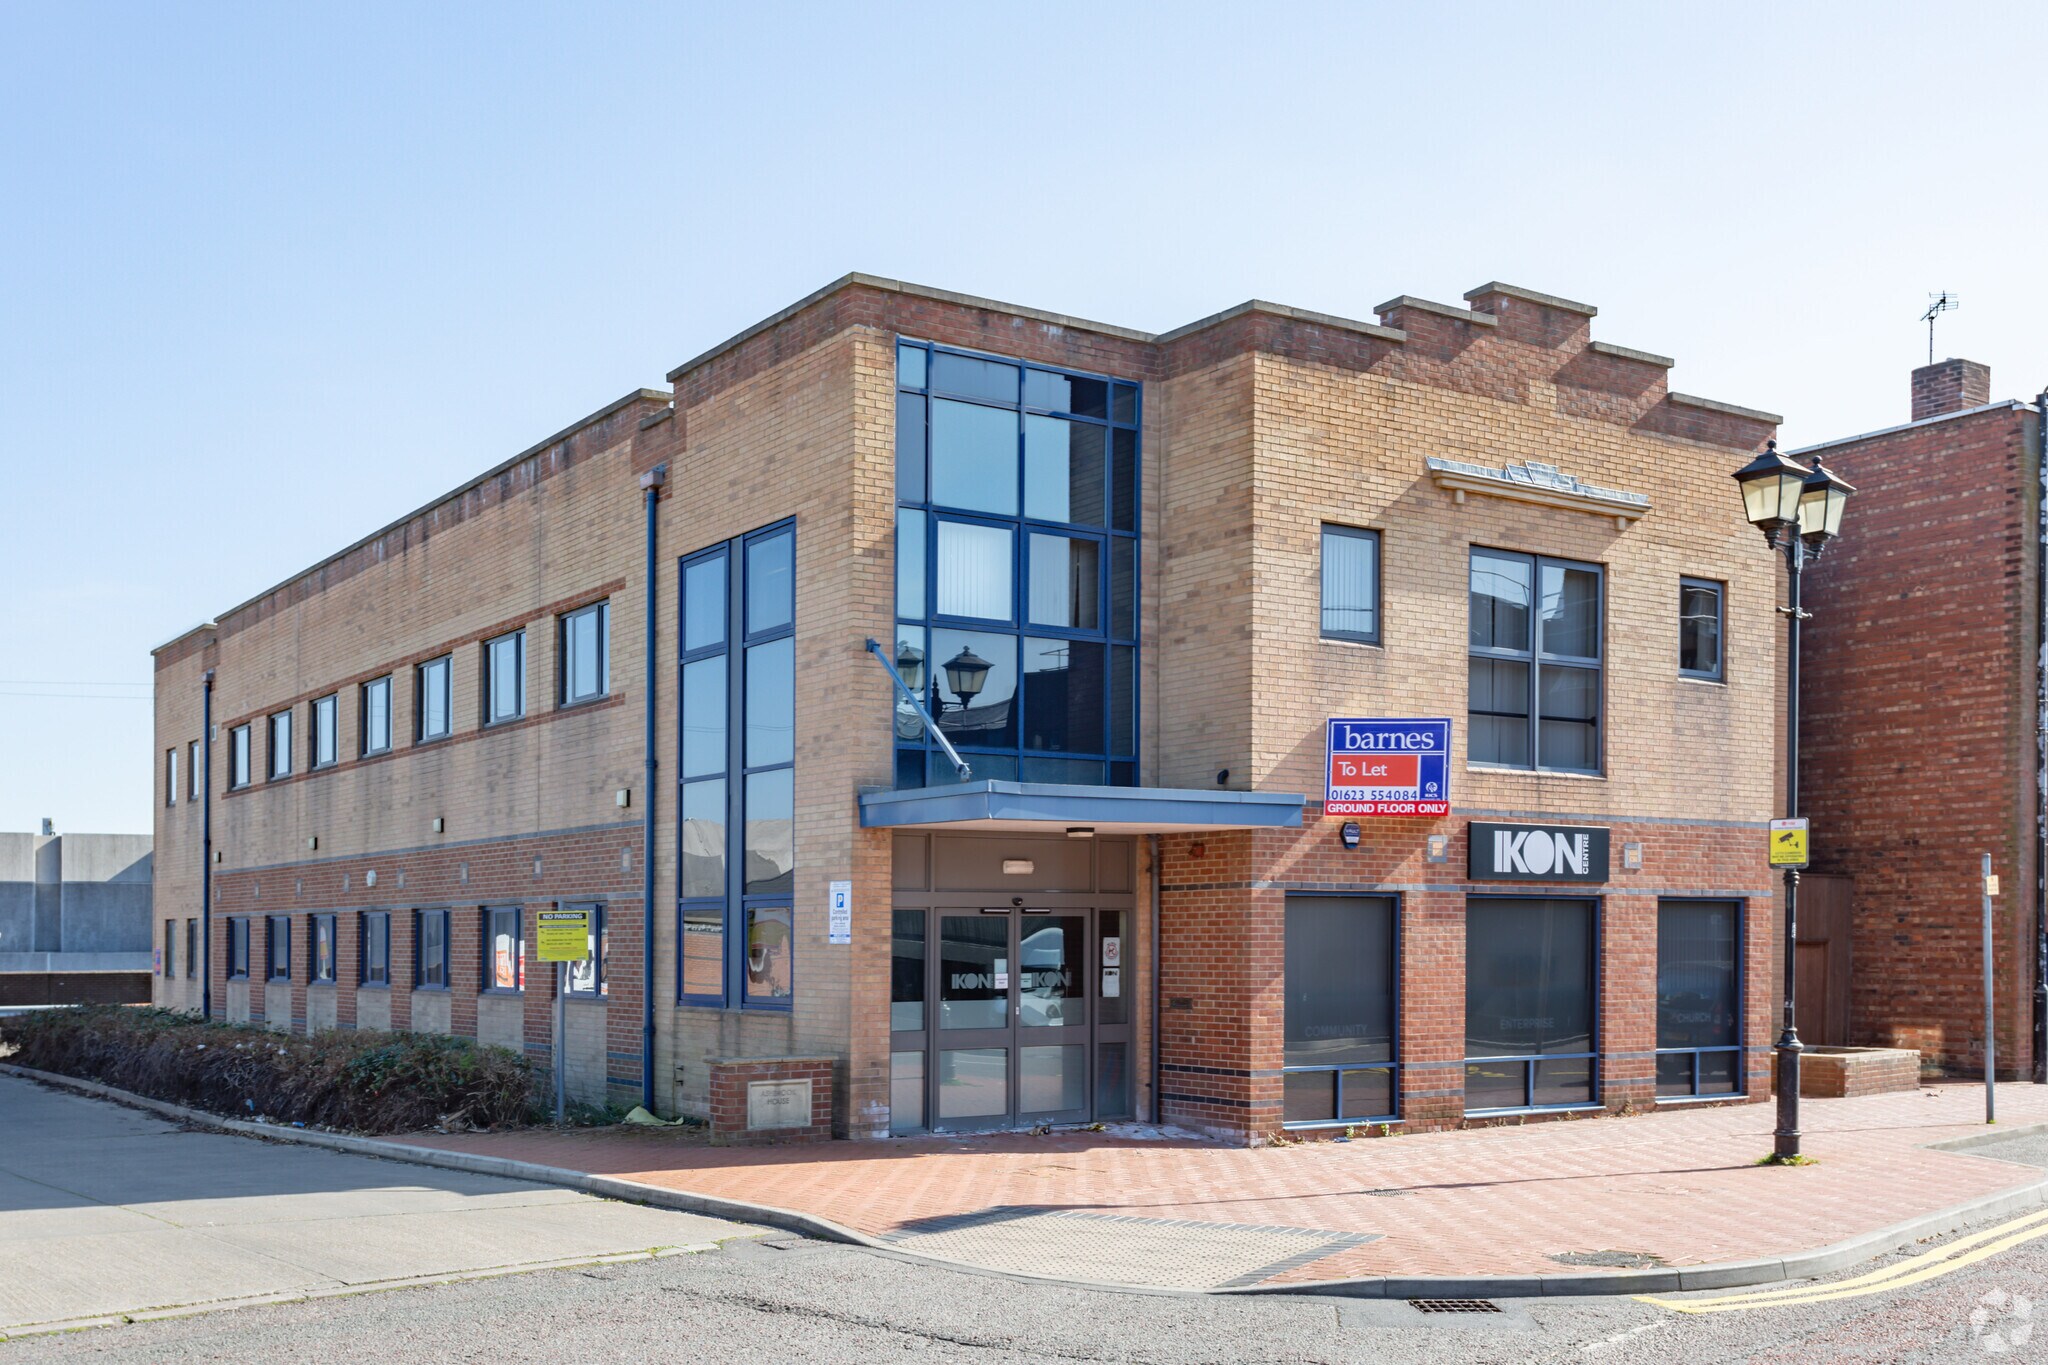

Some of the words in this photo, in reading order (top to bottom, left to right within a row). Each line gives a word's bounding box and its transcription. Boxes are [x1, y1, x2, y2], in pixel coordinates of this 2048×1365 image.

[1343, 725, 1435, 750] barnes
[1337, 761, 1357, 777] To
[1362, 761, 1388, 777] Let
[1331, 790, 1365, 801] 01623
[1371, 790, 1418, 801] 554084
[1327, 803, 1375, 814] GROUND
[1377, 803, 1415, 814] FLOOR
[1418, 803, 1447, 814] ONLY
[1493, 830, 1583, 875] IKON
[1582, 833, 1590, 875] CENTRE
[951, 973, 991, 989] IKON
[1032, 972, 1069, 988] IKON
[1304, 1024, 1368, 1037] COMMUNITY
[1500, 1017, 1555, 1030] ENTERPRISE
